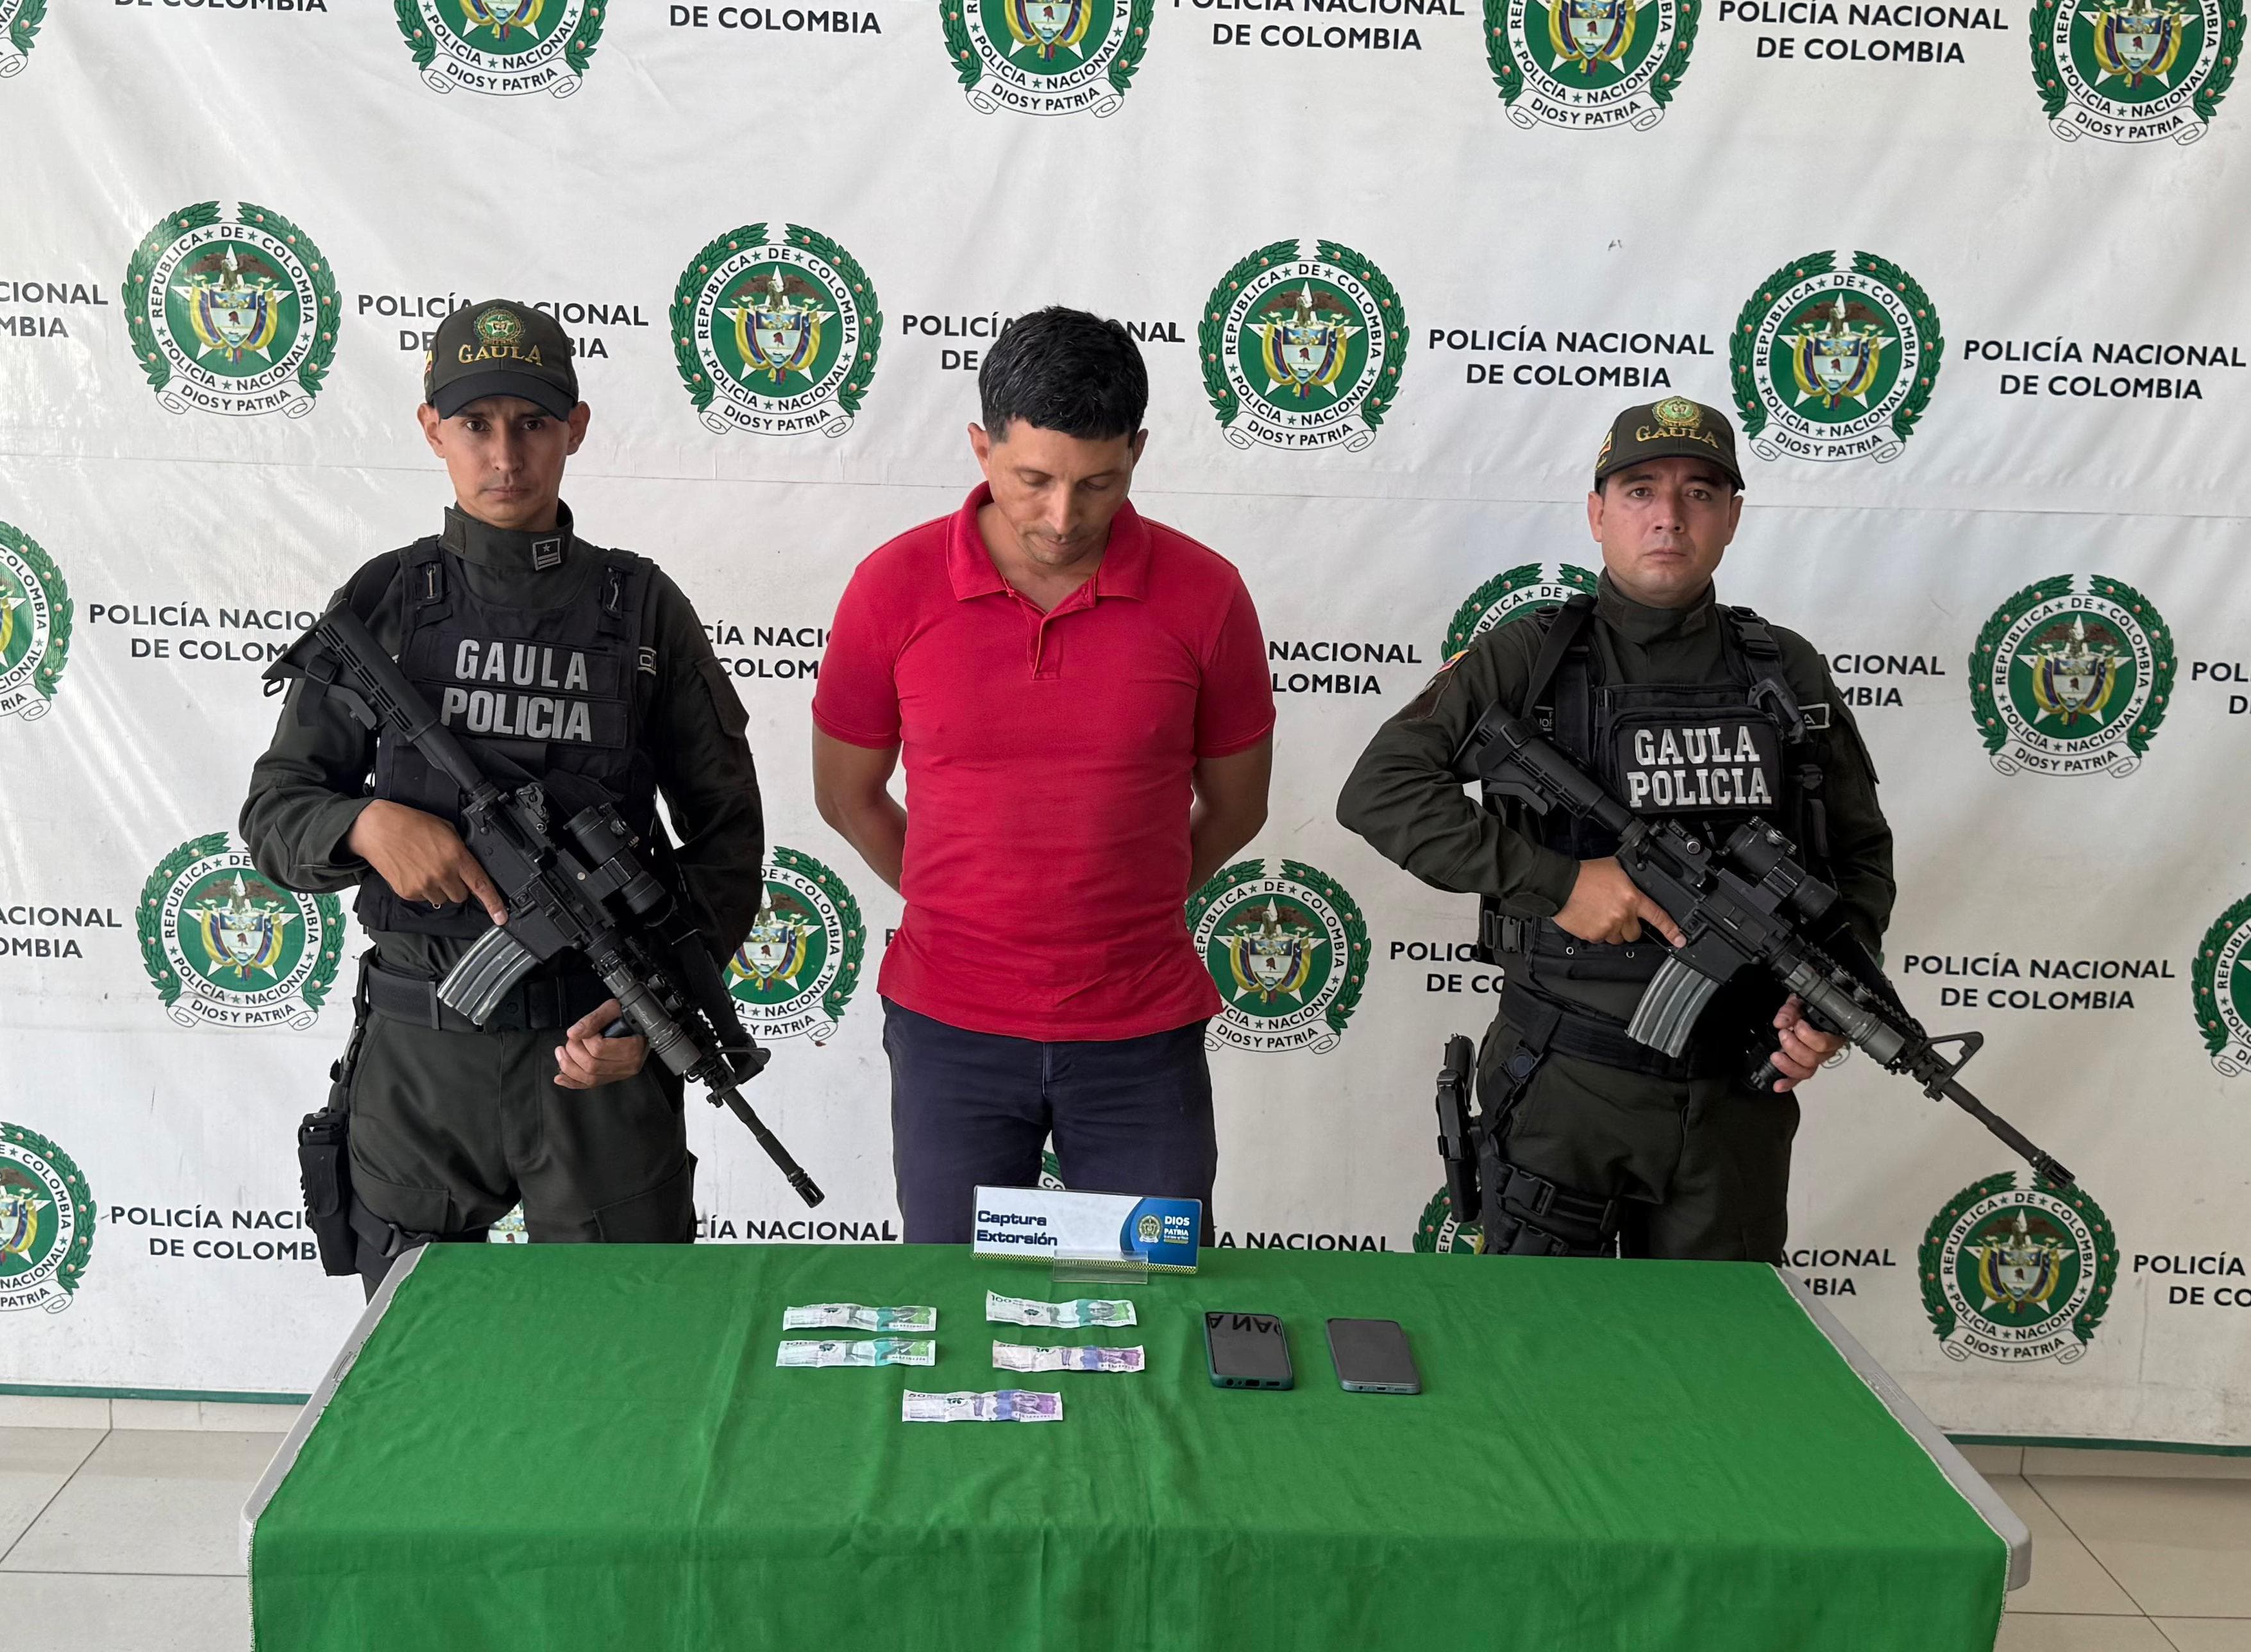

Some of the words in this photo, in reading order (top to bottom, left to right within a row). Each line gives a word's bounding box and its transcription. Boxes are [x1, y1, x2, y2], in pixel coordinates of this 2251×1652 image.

[670, 4, 708, 28] DE
[718, 6, 882, 34] COLOMBIA
[1848, 4, 2009, 30] NACIONAL
[502, 20, 576, 69] NACIONAL
[1213, 23, 1251, 46] DE
[1260, 25, 1422, 50] COLOMBIA
[1757, 37, 1794, 58] DE
[1804, 38, 1965, 63] COLOMBIA
[446, 62, 485, 87] DIOS
[487, 77, 498, 90] Y
[502, 67, 558, 90] PATRIA
[1047, 39, 1120, 89] NACIONAL
[1587, 53, 1663, 104] NACIONAL
[991, 83, 1029, 108] DIOS
[1031, 97, 1041, 110] Y
[1045, 87, 1100, 110] PATRIA
[2131, 69, 2207, 117] NACIONAL
[1531, 97, 1568, 122] DIOS
[1571, 112, 1581, 124] Y
[1585, 101, 1641, 124] PATRIA
[2075, 111, 2112, 135] DIOS
[2114, 125, 2124, 138] Y
[2129, 115, 2184, 138] PATRIA
[221, 226, 243, 239] DE
[262, 237, 314, 323] COLOMBIA
[768, 248, 790, 260] DE
[808, 259, 856, 344] COLOMBIA
[1299, 264, 1320, 276] DE
[1337, 274, 1382, 358] COLOMBIA
[1834, 275, 1856, 287] DE
[1872, 285, 1915, 369] COLOMBIA
[1429, 324, 1547, 352] POLICÍA
[1556, 332, 1714, 355] NACIONAL
[1964, 336, 2083, 363] POLICÍA
[2093, 342, 2247, 367] NACIONAL
[236, 344, 308, 391] NACIONAL
[458, 344, 543, 367] GAULA
[941, 350, 978, 371] DE
[778, 364, 848, 411] NACIONAL
[1467, 364, 1504, 384] DE
[1513, 364, 1671, 388] COLOMBIA
[2000, 375, 2039, 395] DE
[2048, 375, 2203, 400] COLOMBIA
[181, 384, 219, 408] DIOS
[221, 398, 232, 410] Y
[237, 389, 291, 411] PATRIA
[1301, 378, 1373, 426] NACIONAL
[723, 405, 761, 428] DIOS
[763, 418, 773, 430] Y
[777, 409, 830, 431] PATRIA
[1830, 389, 1905, 437] NACIONAL
[1247, 419, 1283, 443] DIOS
[1285, 433, 1295, 445] Y
[1300, 423, 1353, 446] PATRIA
[1635, 425, 1719, 449] GAULA
[1775, 431, 1811, 455] DIOS
[1814, 444, 1823, 457] Y
[1828, 435, 1883, 457] PATRIA
[1540, 586, 1562, 598] DE
[90, 601, 210, 627] POLICÍA
[219, 608, 321, 632] NACIO
[131, 638, 170, 658] DE
[179, 639, 289, 662] COLOM
[754, 627, 829, 648] NACI
[2071, 597, 2093, 609] DE
[2109, 608, 2150, 688] COLOMBIA
[455, 639, 589, 691] GAULA
[1269, 641, 1422, 664] NACIONAL
[1828, 654, 1946, 675] CIONAL
[1272, 673, 1381, 695] LOMBIA
[440, 687, 592, 742] POLICIA
[2068, 707, 2140, 753] NACIONAL
[1635, 725, 1760, 766] GAULA
[2014, 747, 2050, 769] DIOS
[2052, 760, 2061, 771] Y
[2065, 750, 2118, 771] PATRIA
[1626, 767, 1773, 808] POLICIA
[230, 854, 251, 866] DE
[0, 906, 122, 928] CIONAL
[795, 878, 840, 955] COLOMBIA
[1264, 881, 1285, 892] DE
[1301, 891, 1345, 968] COLOMBIA
[1390, 941, 1474, 963] POLIC
[1903, 952, 2020, 978] POLICÍA
[2030, 959, 2175, 979] NACIONAL
[244, 962, 312, 1006] NACIONAL
[764, 973, 833, 1017] NACIONAL
[1426, 973, 1462, 993] DE
[192, 999, 228, 1021] DIOS
[230, 1012, 240, 1023] Y
[244, 1004, 297, 1024] PATRIA
[1268, 986, 1337, 1030] NACIONAL
[1941, 988, 1978, 1007] DE
[1987, 990, 2135, 1011] COLOMBIA
[750, 1024, 760, 1035] Y
[764, 1015, 816, 1036] PATRIA
[1216, 1024, 1251, 1045] DIOS
[1253, 1036, 1263, 1047] Y
[1267, 1027, 1319, 1048] PATRIA
[22, 1153, 71, 1229] COLOMBIA
[111, 1204, 223, 1229] POLICÍA
[232, 1210, 308, 1229] NACI
[977, 1210, 1047, 1227] Captura
[1164, 1215, 1190, 1226] DIOS
[746, 1220, 898, 1242] NACIONAL
[976, 1229, 1058, 1247] Extorsión
[1163, 1227, 1189, 1236] PATRIA
[2014, 1192, 2036, 1204] DE
[2052, 1202, 2093, 1279] COLOMBIA
[149, 1238, 185, 1257] DE
[193, 1240, 317, 1260] COLOMB
[0, 1247, 65, 1289] NACIONAL
[2134, 1251, 2247, 1277] POLICÍA
[0, 1287, 51, 1307] PATRIA
[2169, 1286, 2205, 1305] DE
[2015, 1297, 2085, 1340] NACIONAL
[1963, 1334, 1998, 1355] DIOS
[2000, 1346, 2010, 1358] Y
[2014, 1337, 2065, 1358] PATRIA
